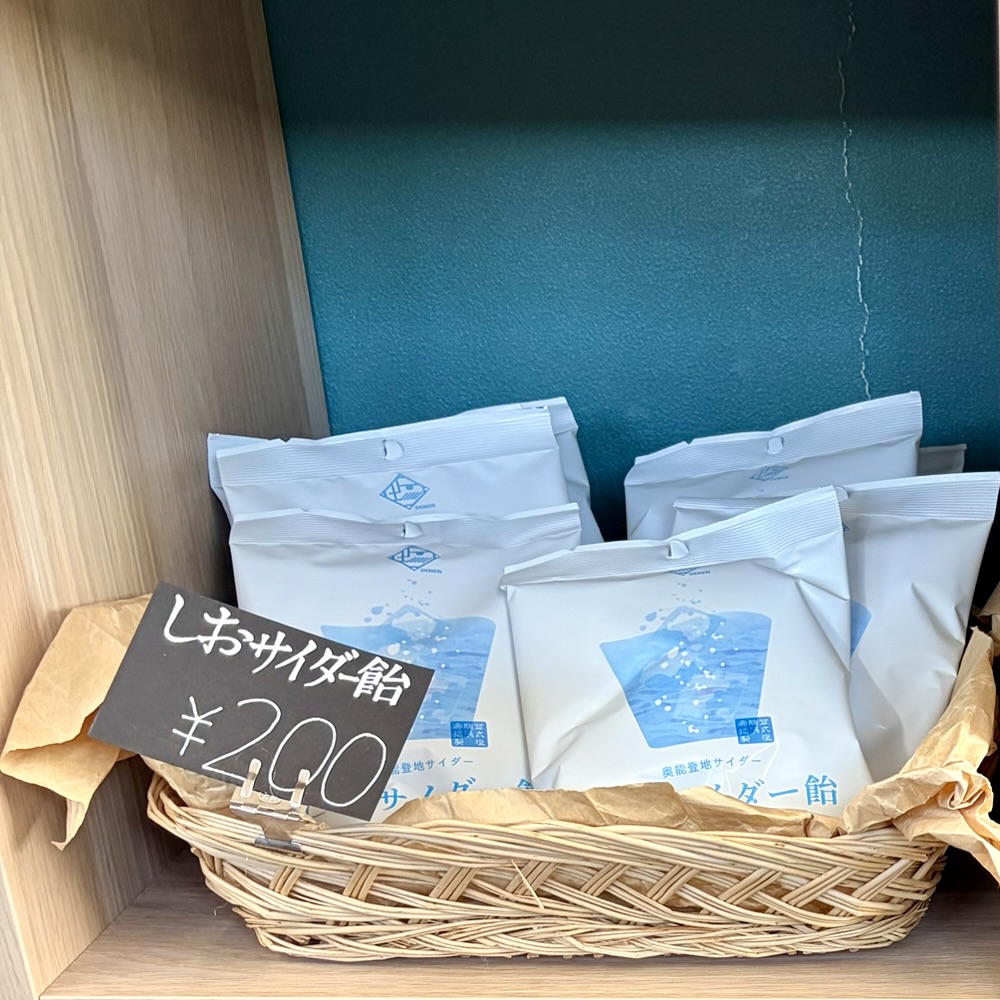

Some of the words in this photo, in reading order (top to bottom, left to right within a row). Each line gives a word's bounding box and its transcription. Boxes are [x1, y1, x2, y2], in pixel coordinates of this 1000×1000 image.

[163, 593, 411, 706] しおサイダー飴
[172, 695, 387, 808] ¥200
[662, 755, 761, 778] 奥能登地サイダー
[713, 774, 838, 806] ダー飴
